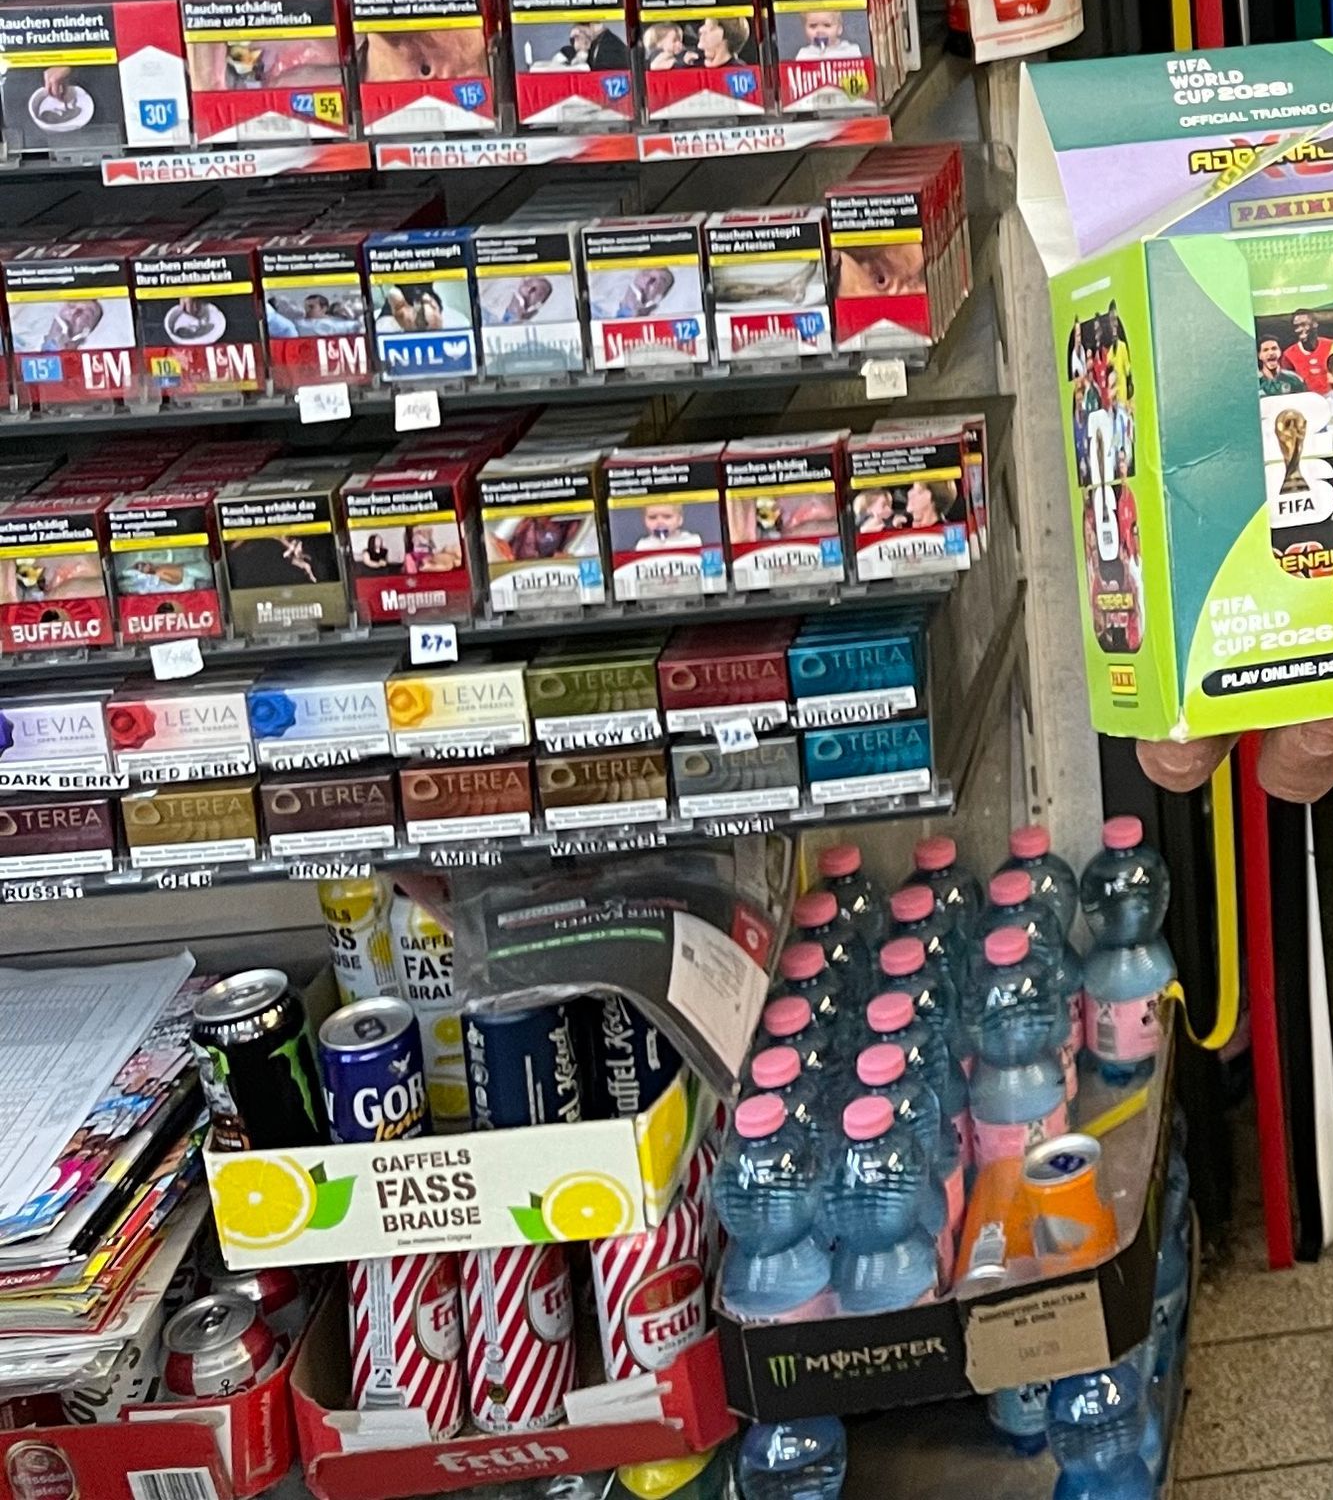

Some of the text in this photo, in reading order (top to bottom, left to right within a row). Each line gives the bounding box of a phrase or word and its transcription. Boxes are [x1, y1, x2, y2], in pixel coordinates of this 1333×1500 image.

[1167, 58, 1212, 74] FIFA
[1170, 70, 1244, 89] WORLD
[1174, 89, 1214, 105] CUP
[1180, 112, 1248, 127] OFFICIAL
[1250, 105, 1317, 120] TRADING
[140, 161, 257, 179] REDLAND
[1279, 498, 1314, 514] FIFA
[1210, 594, 1256, 615] FIFA
[11, 621, 102, 644] BUFFALO
[1210, 611, 1290, 636] WORLD
[1212, 637, 1256, 656] CUP
[1222, 669, 1259, 688] PLAY
[21, 718, 94, 737] LEVIA
[547, 730, 624, 751] YELLOW
[23, 809, 101, 828] TEREA
[372, 1150, 471, 1173] GAFFELS
[376, 1172, 477, 1209] FASS
[382, 1206, 481, 1232] BRAUSE
